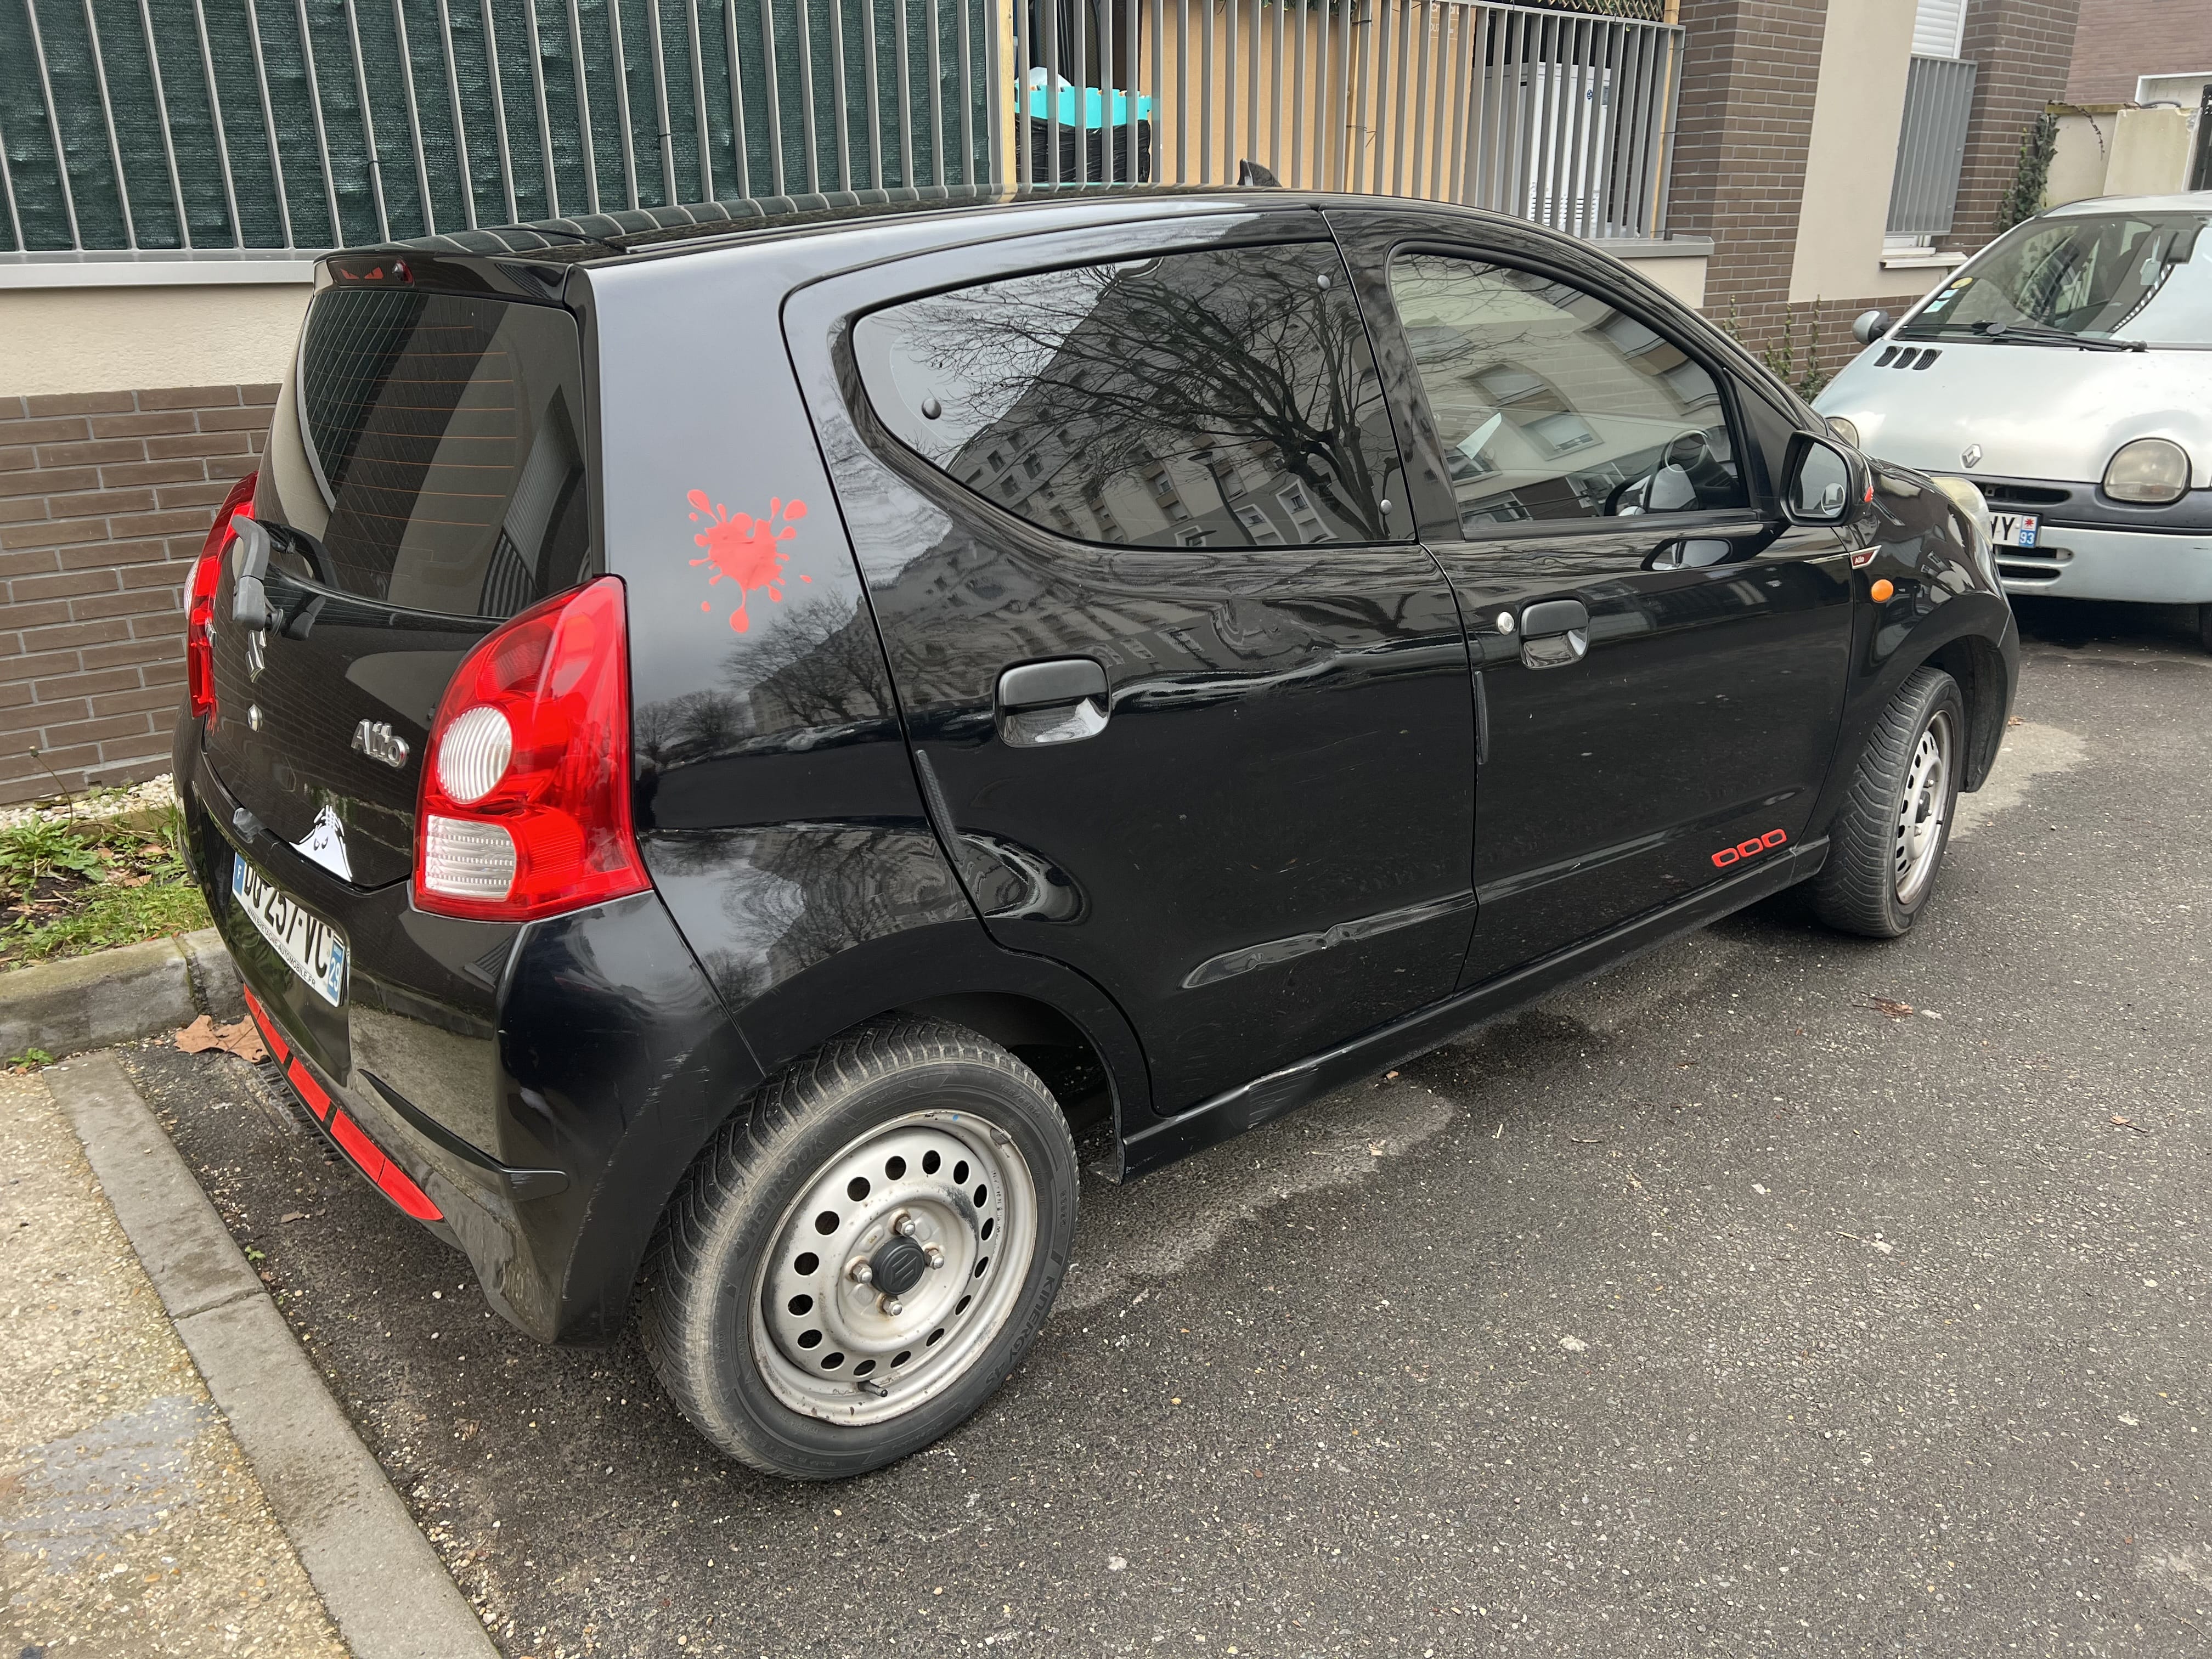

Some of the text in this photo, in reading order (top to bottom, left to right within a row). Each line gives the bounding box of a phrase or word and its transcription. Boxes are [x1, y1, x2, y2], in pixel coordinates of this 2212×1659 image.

[2019, 532, 2034, 545] 93
[351, 719, 410, 768] Alto
[237, 865, 242, 879] F
[247, 905, 317, 988] WWW.BRETAGNE-AUTOMOBILE.FR
[329, 957, 341, 992] 29
